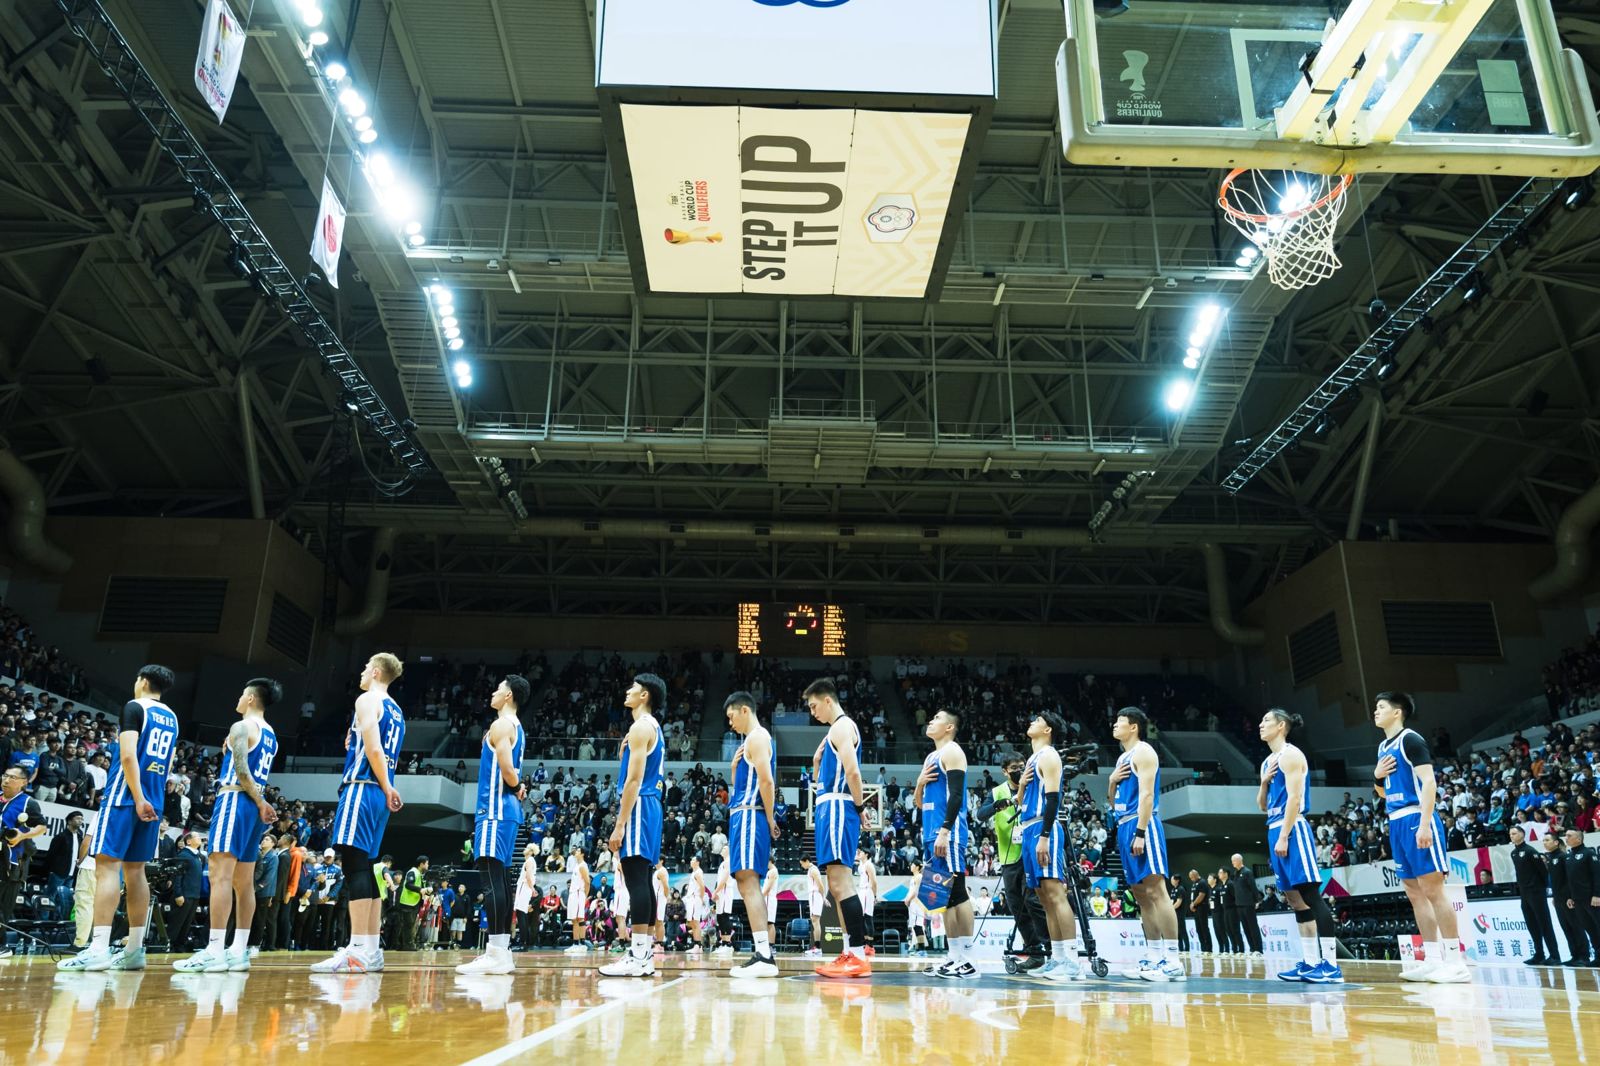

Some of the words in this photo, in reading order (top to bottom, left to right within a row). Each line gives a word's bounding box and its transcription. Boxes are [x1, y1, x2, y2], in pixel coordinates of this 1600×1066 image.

[684, 180, 694, 195] CUP
[740, 134, 846, 214] UP
[686, 196, 696, 221] WORLD
[695, 180, 711, 222] QUALIFIERS
[742, 218, 787, 281] STEP
[793, 220, 839, 248] IT
[146, 727, 174, 760] 88
